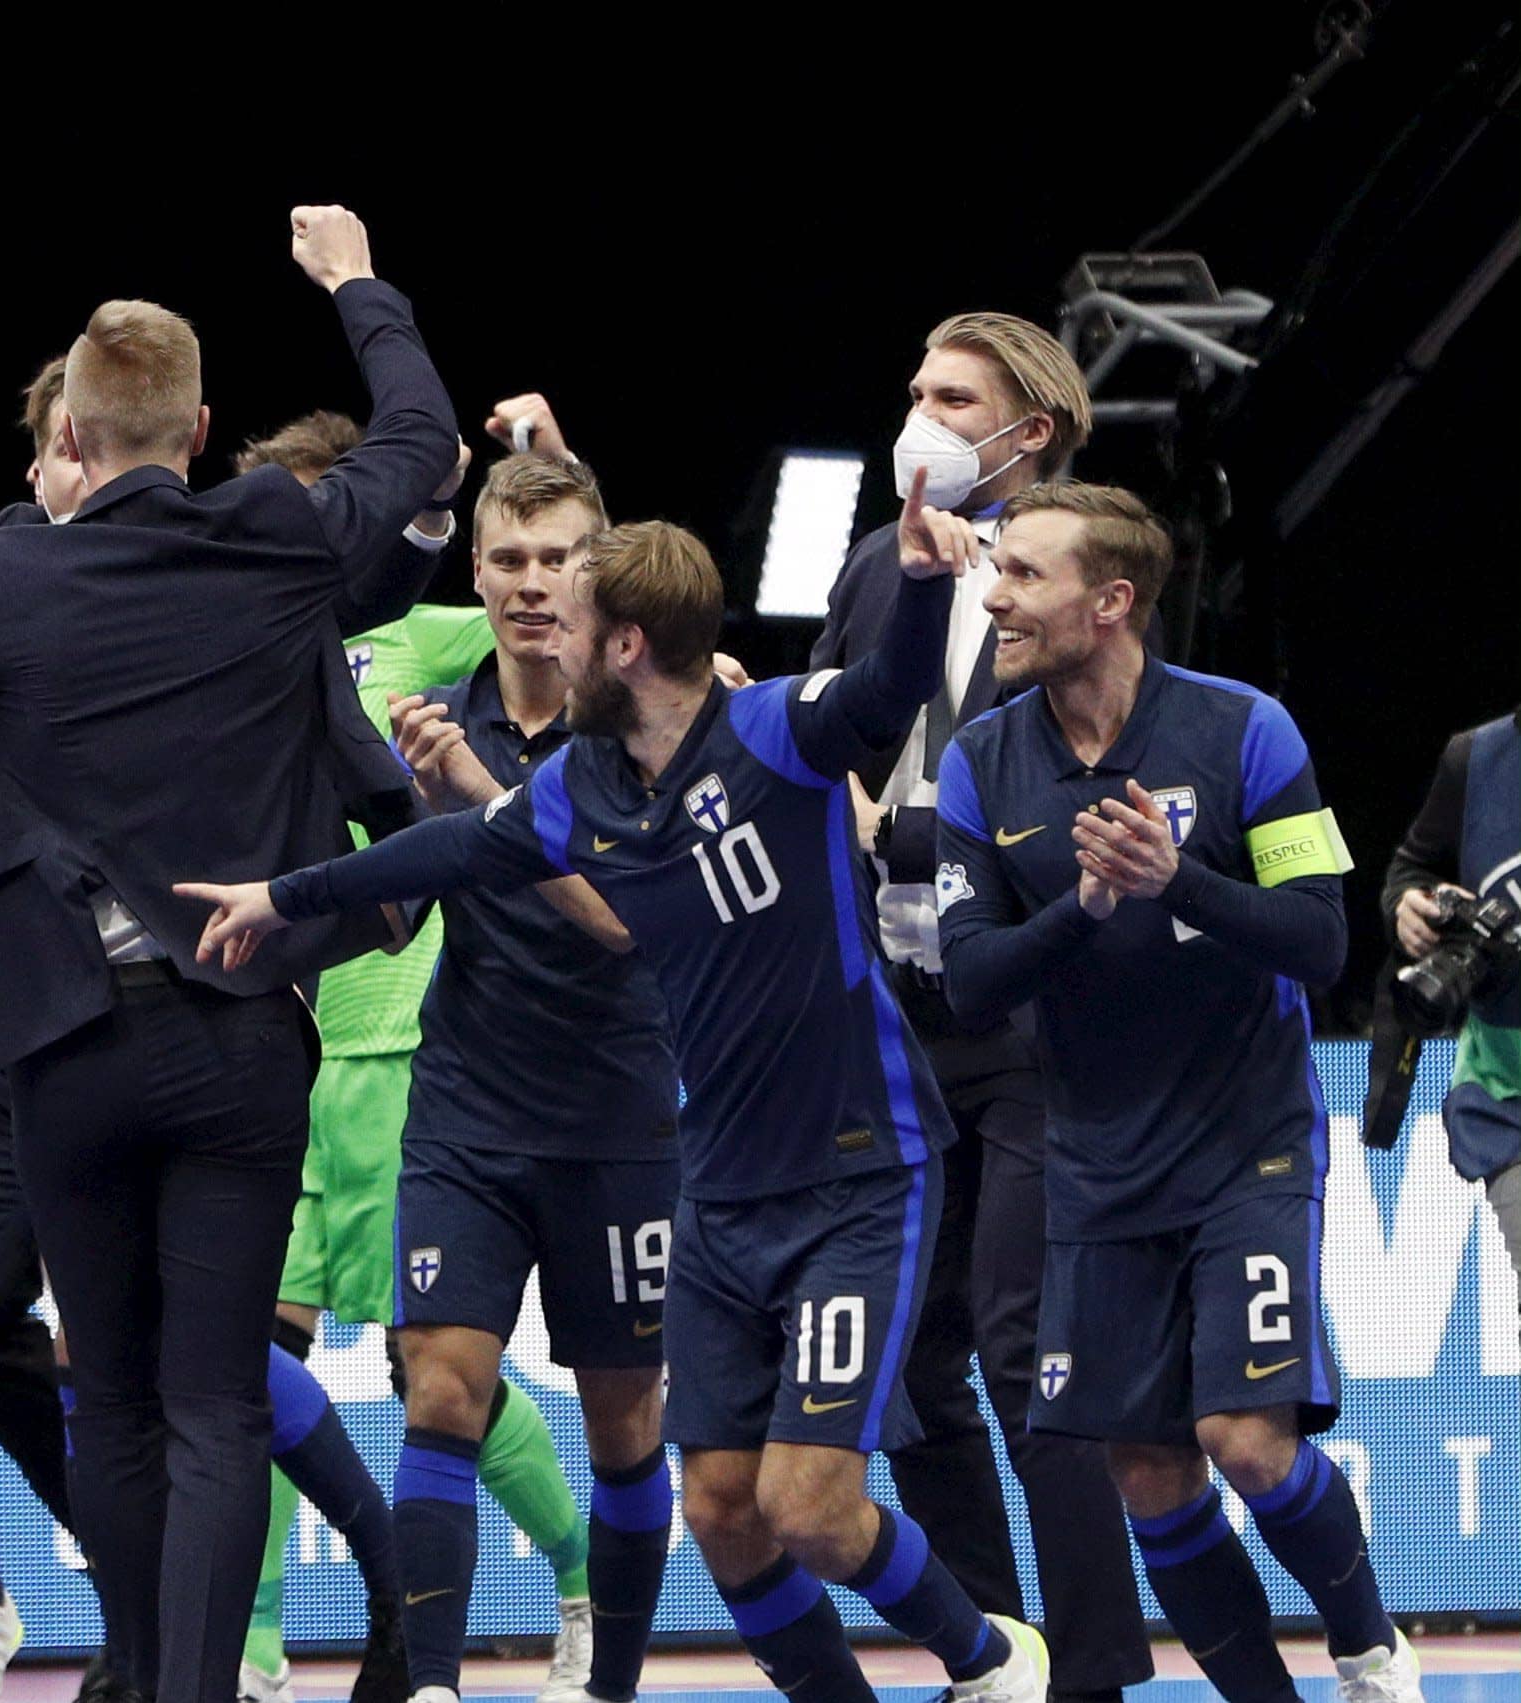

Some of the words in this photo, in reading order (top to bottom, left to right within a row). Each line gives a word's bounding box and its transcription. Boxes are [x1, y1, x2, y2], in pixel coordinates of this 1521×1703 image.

[691, 821, 781, 924] 10
[1256, 839, 1317, 866] RESPECT
[608, 1219, 672, 1303] 19
[1246, 1255, 1292, 1343] 2
[797, 1297, 864, 1384] 10
